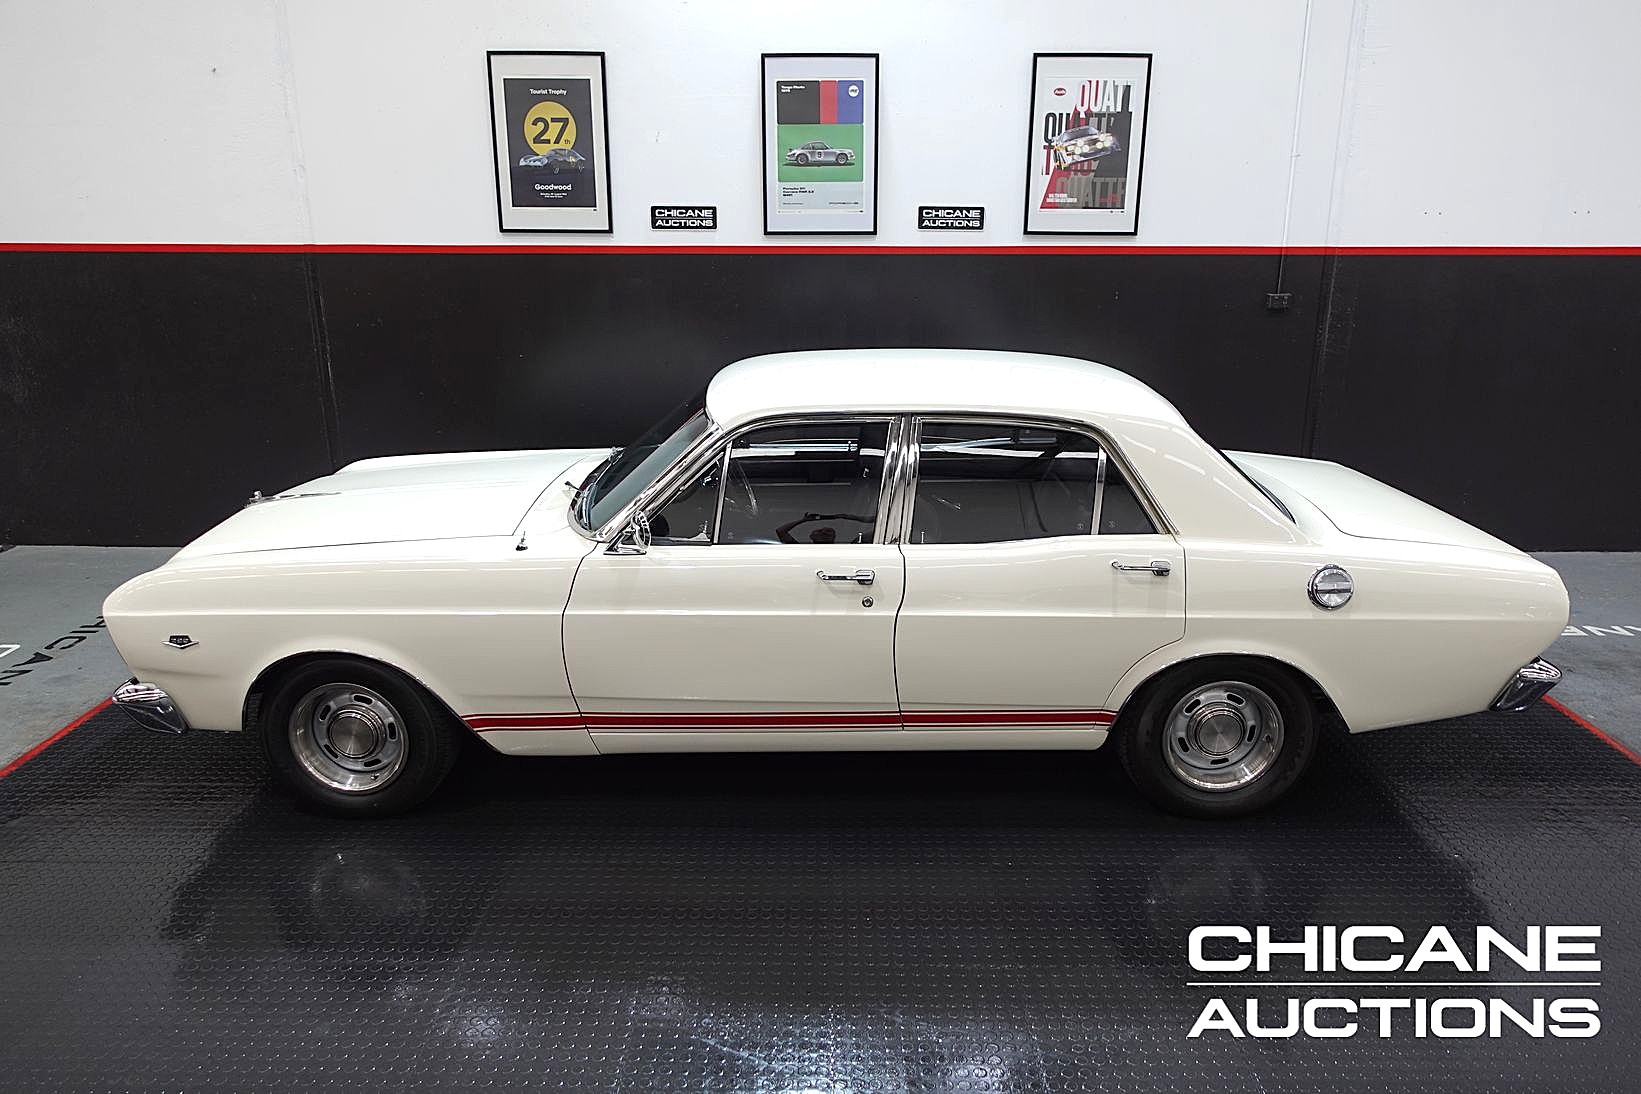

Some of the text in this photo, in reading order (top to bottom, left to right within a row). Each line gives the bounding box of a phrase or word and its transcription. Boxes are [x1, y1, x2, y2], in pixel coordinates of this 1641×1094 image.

[549, 88, 567, 96] Trophy
[534, 183, 572, 191] Goodwood
[655, 209, 713, 217] CHICANE
[922, 209, 981, 218] CHICANE
[655, 219, 713, 227] AUCTIONS
[922, 219, 980, 227] AUCTIONS
